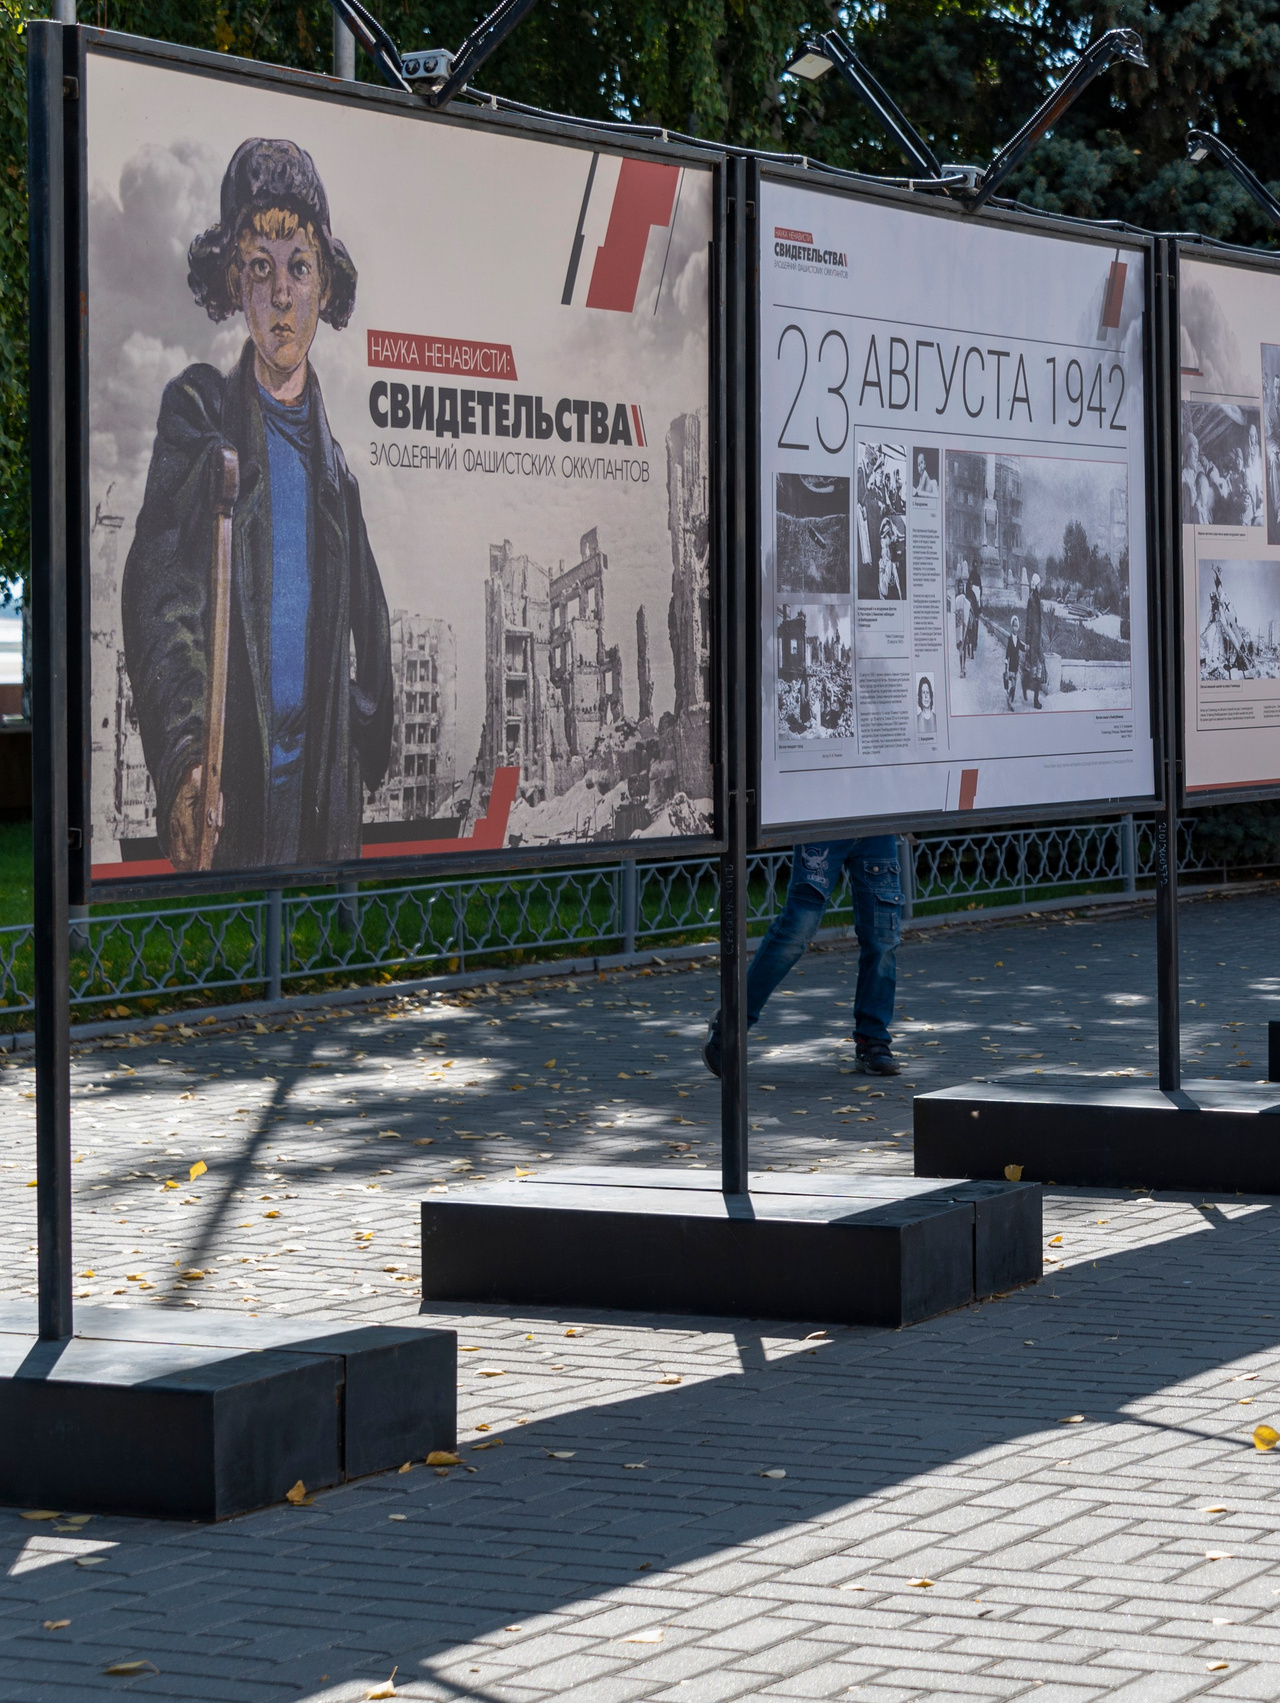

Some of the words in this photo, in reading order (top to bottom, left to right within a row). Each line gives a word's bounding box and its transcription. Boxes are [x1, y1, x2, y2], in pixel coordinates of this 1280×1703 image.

[774, 242, 844, 267] СВИДЕТЕЛЬСТВА
[371, 336, 419, 364] НАУКА
[425, 342, 511, 374] НЕНАВИСТИ:
[777, 324, 850, 455] 23
[859, 334, 1033, 423] АВГУСТА
[1045, 357, 1127, 431] 1942
[368, 380, 633, 446] СВИДЕТЕЛЬСТВА
[370, 441, 458, 471] ЗЛОДЕЯНИЙ
[462, 447, 557, 477] ФАШИСТСКИХ
[561, 455, 650, 482] ОККУПАНТОВ
